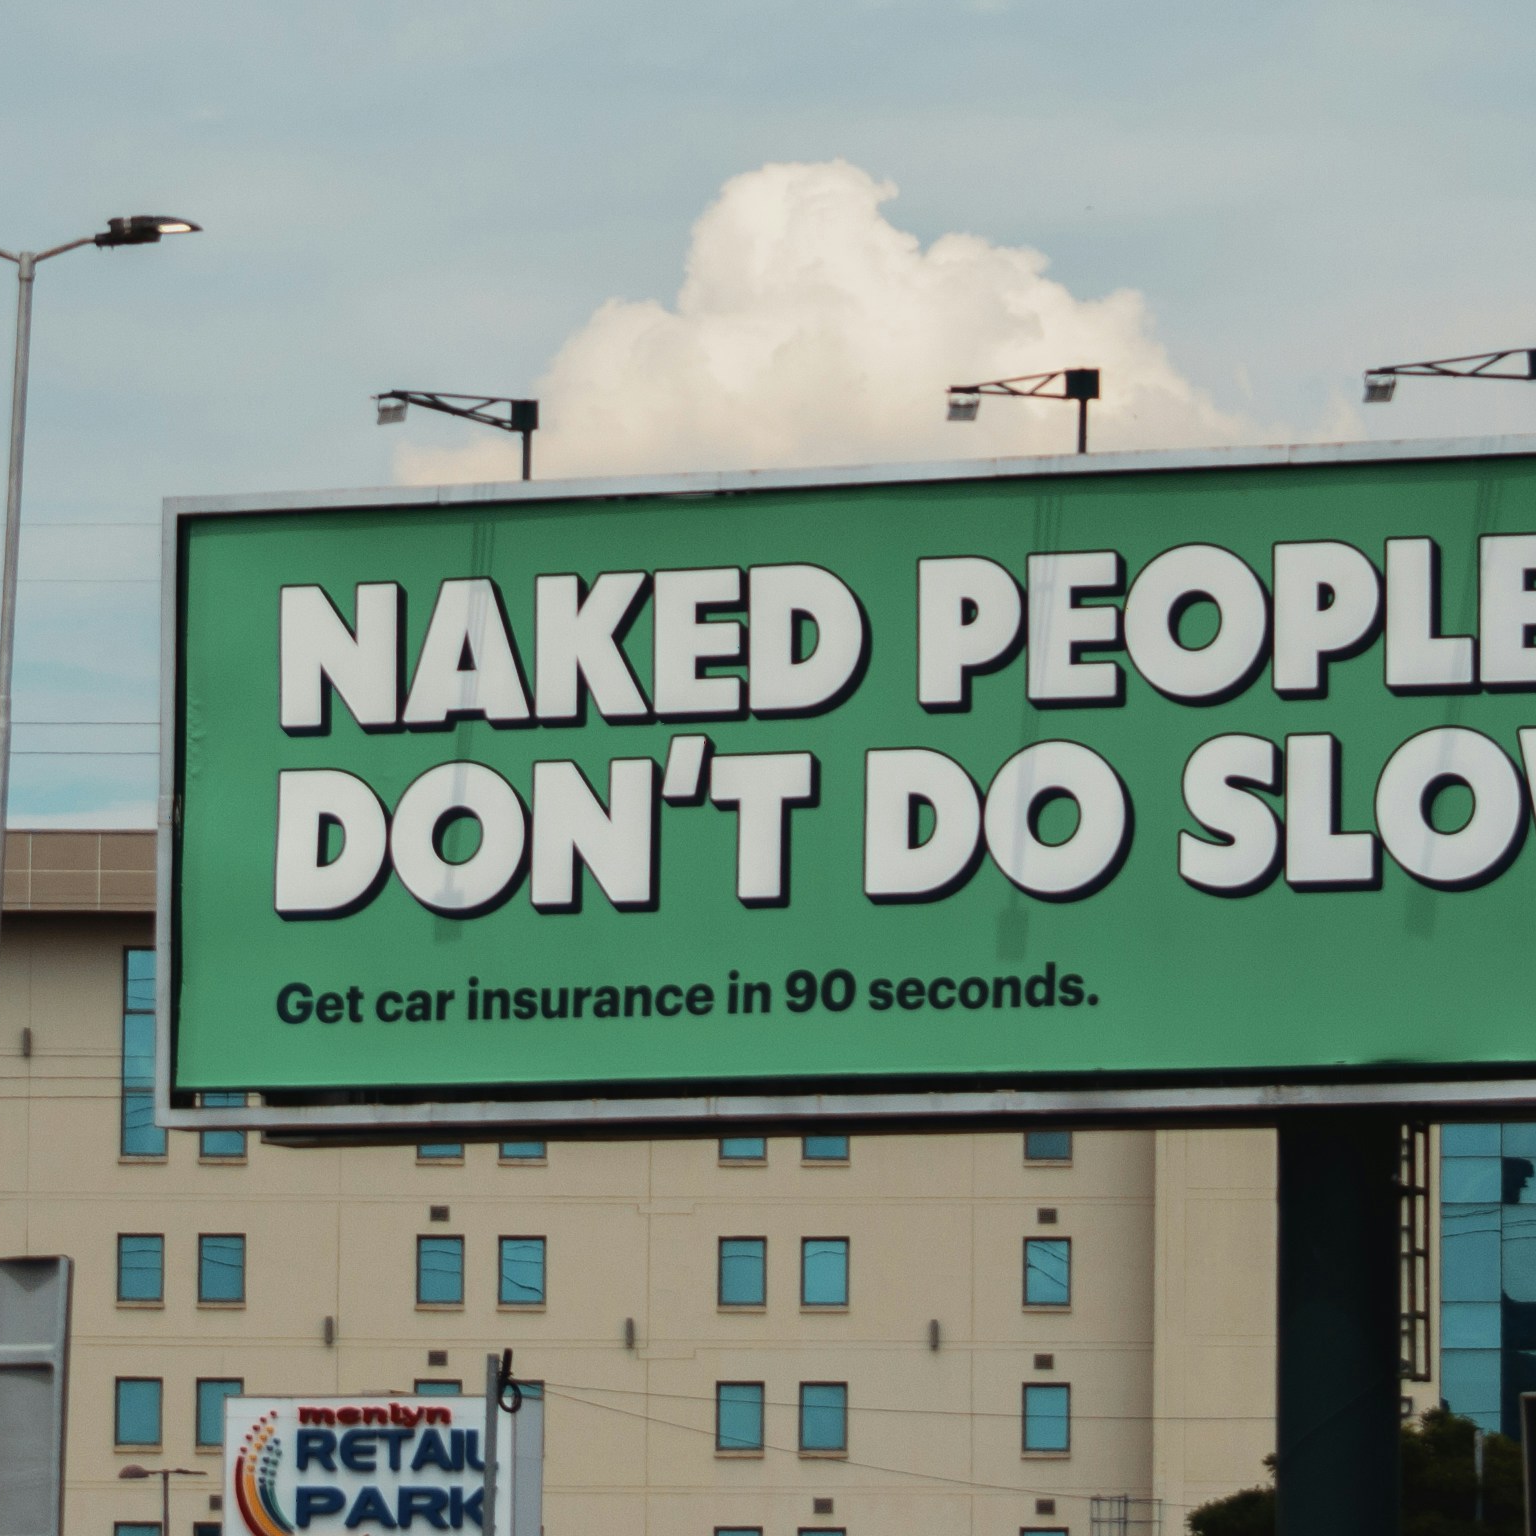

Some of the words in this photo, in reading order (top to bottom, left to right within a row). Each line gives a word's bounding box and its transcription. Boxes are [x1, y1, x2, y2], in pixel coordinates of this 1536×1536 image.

[278, 562, 872, 736] NAKED
[273, 734, 821, 920] DON'T
[864, 739, 1135, 905] DO
[276, 981, 363, 1024] Get
[375, 989, 455, 1022] car
[467, 975, 714, 1021] insurance
[727, 969, 772, 1014] in
[785, 968, 857, 1012] 90
[868, 961, 1100, 1012] seconds.
[296, 1428, 498, 1473] RETAIL
[295, 1486, 488, 1529] PARK
